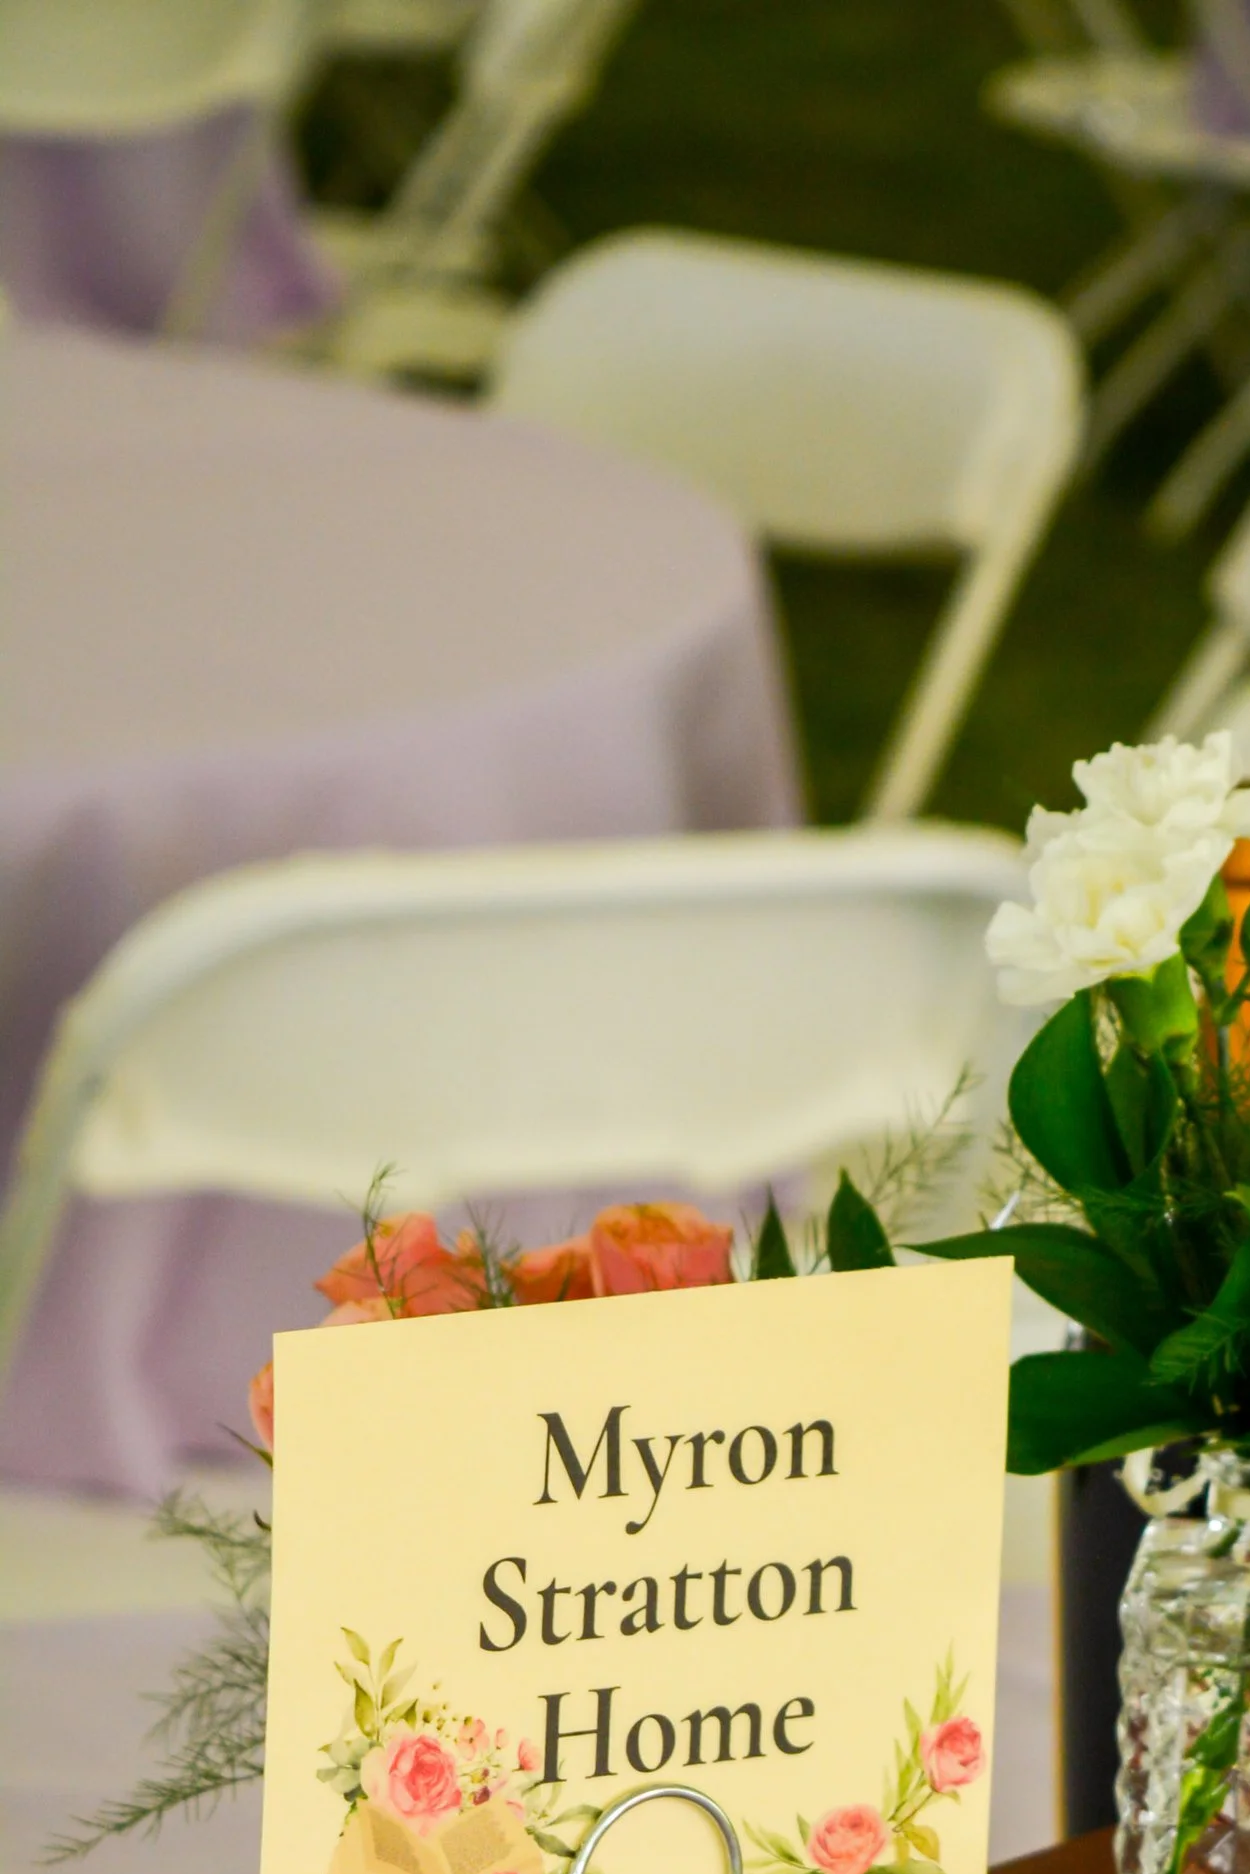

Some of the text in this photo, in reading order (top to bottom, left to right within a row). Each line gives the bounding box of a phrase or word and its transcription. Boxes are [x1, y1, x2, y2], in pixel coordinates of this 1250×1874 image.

[532, 1404, 840, 1535] Myron
[478, 1554, 858, 1652] Stratton
[538, 1685, 816, 1785] Home
